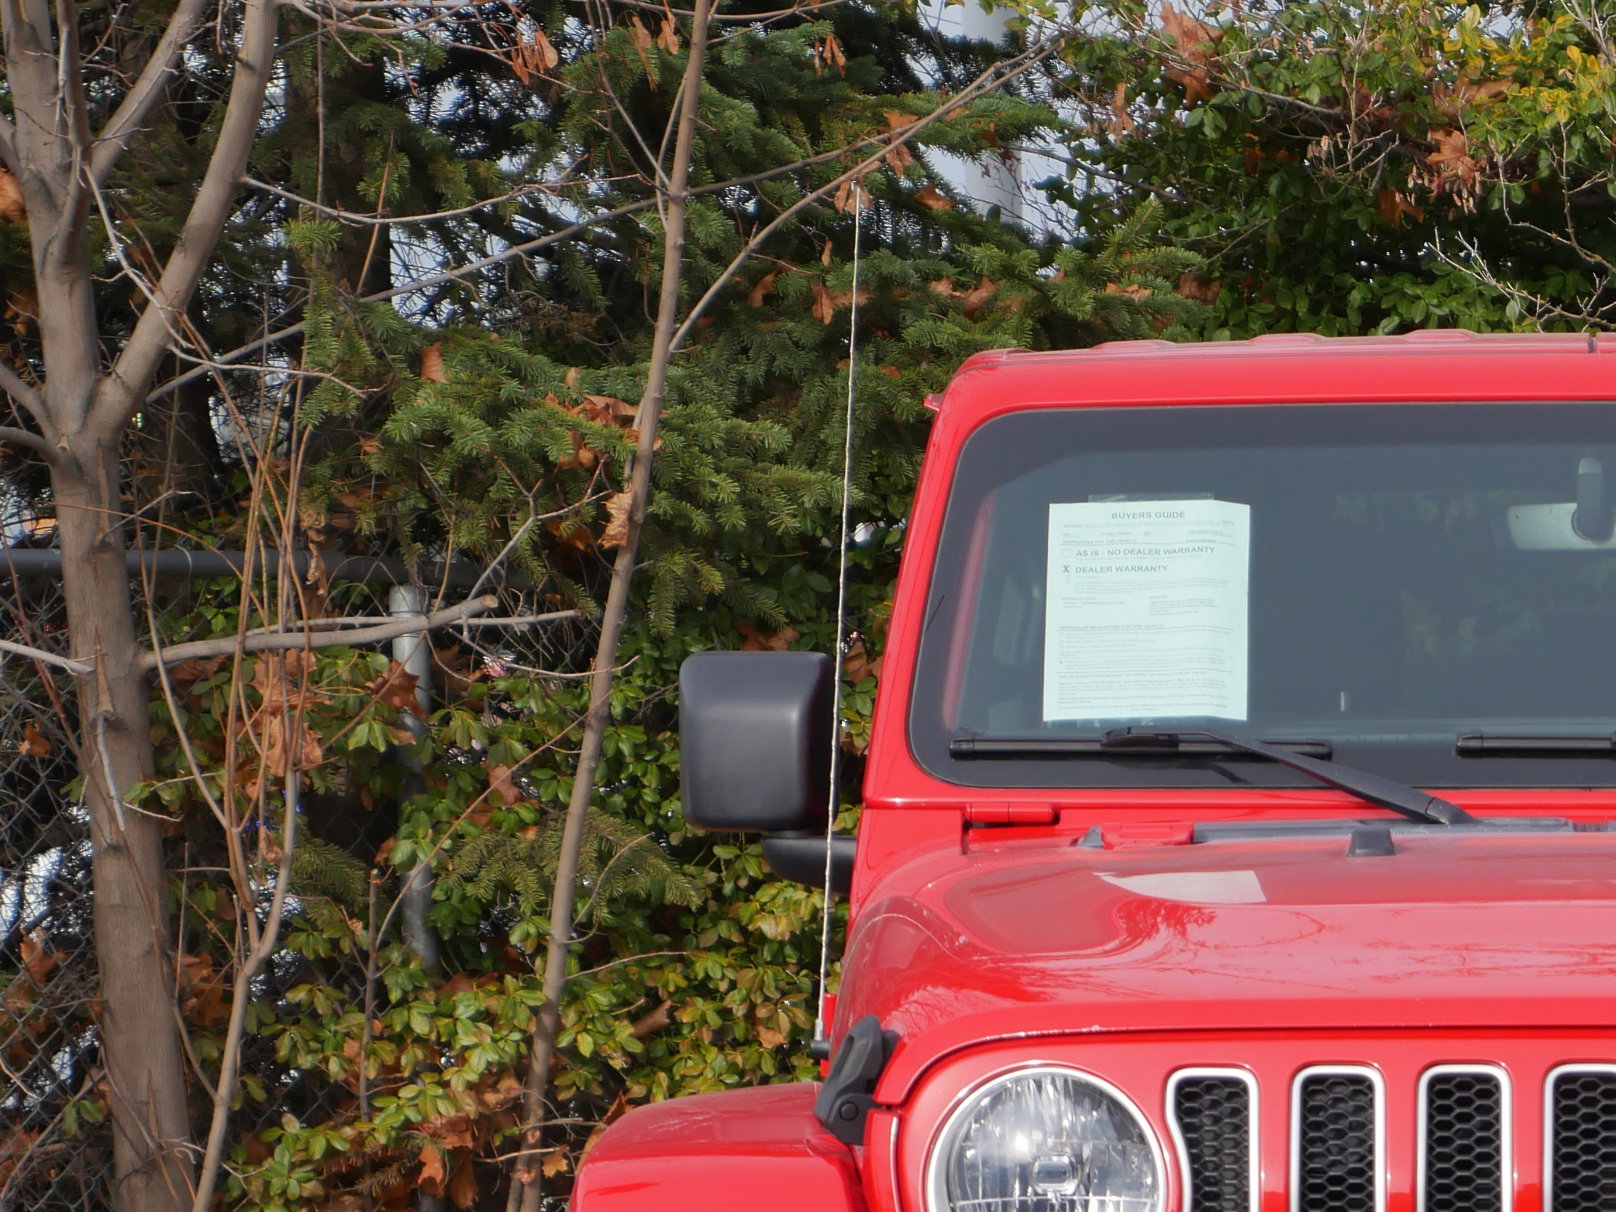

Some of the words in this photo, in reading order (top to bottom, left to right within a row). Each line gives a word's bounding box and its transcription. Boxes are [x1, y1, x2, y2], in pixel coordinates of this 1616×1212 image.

[1111, 511, 1152, 520] BUYERS
[1154, 511, 1186, 519] GUIDE
[1076, 549, 1088, 557] AS
[1090, 549, 1100, 557] IS
[1107, 548, 1121, 556] NO
[1123, 547, 1161, 556] DEALER
[1163, 545, 1216, 556] WARRANTY
[1062, 564, 1071, 574] X
[1075, 566, 1113, 574] DEALER
[1115, 564, 1168, 573] WARRANTY
